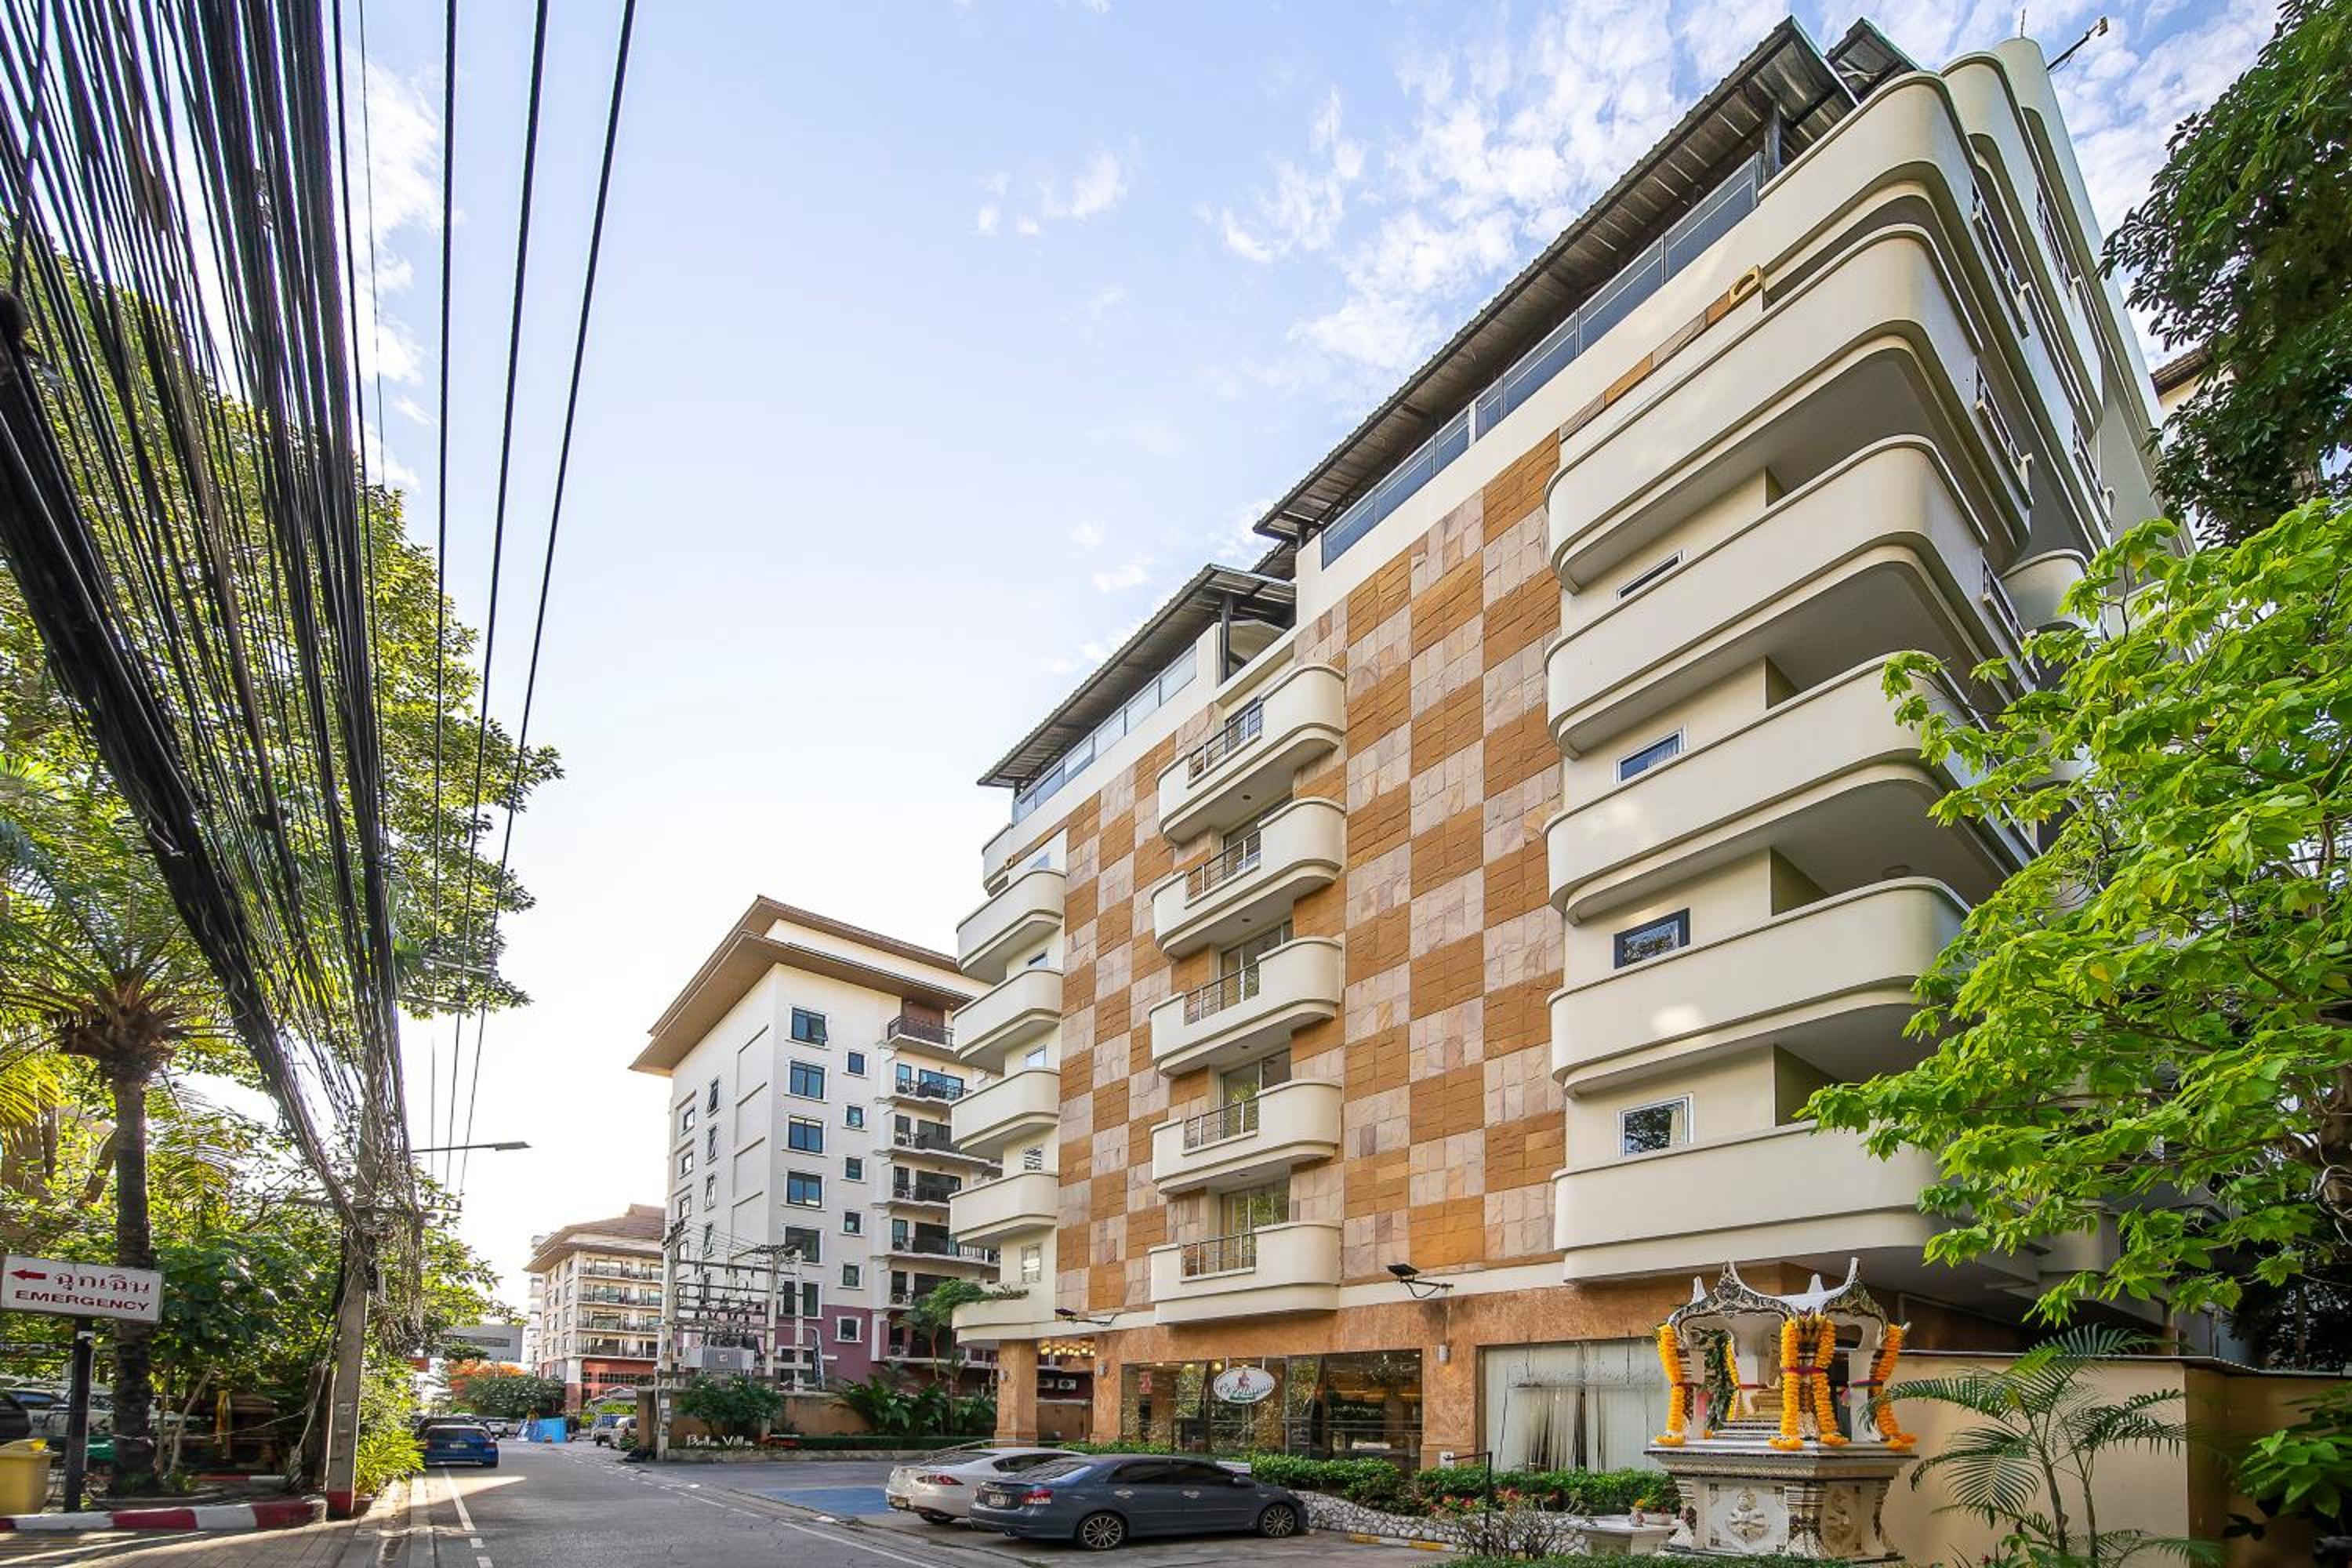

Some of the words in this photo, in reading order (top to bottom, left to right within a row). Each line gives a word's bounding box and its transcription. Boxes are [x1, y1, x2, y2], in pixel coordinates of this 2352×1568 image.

[54, 1272, 150, 1294] ฉุกเฉิน
[15, 1290, 151, 1312] EMERGENCY
